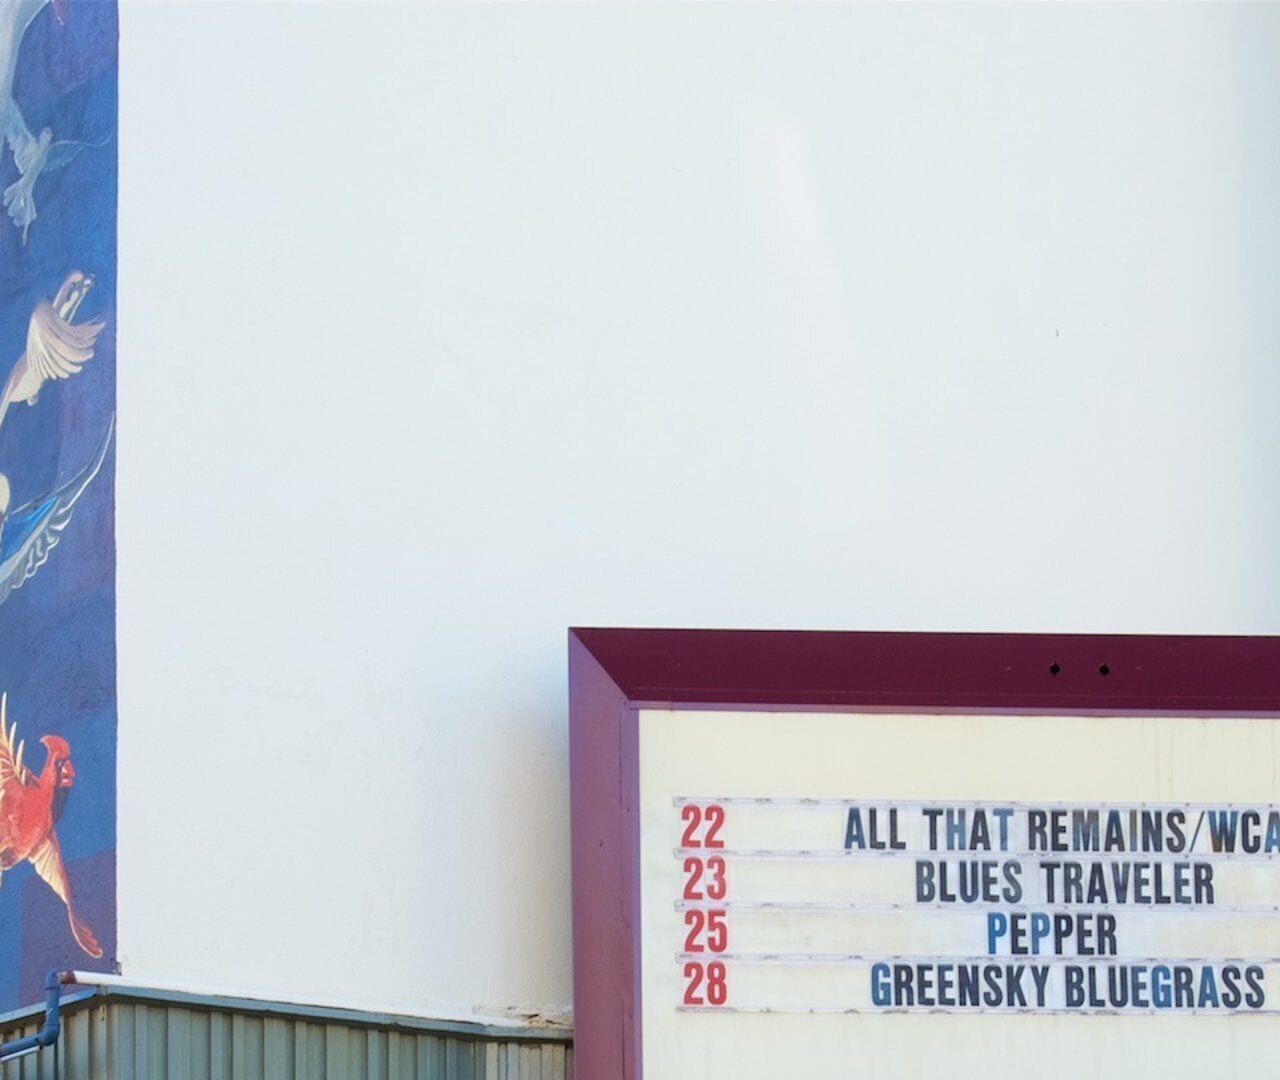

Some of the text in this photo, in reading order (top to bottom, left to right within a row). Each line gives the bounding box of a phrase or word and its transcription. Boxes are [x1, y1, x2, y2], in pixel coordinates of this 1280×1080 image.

[681, 804, 725, 849] 22
[844, 807, 906, 850] ALL
[923, 808, 1014, 851] THAT
[682, 855, 1215, 905] 23 BLUES TRAVELER
[684, 909, 1117, 955] 25 PEPPER
[684, 961, 1265, 1009] 28 GREENSKY BLUEGRASS
